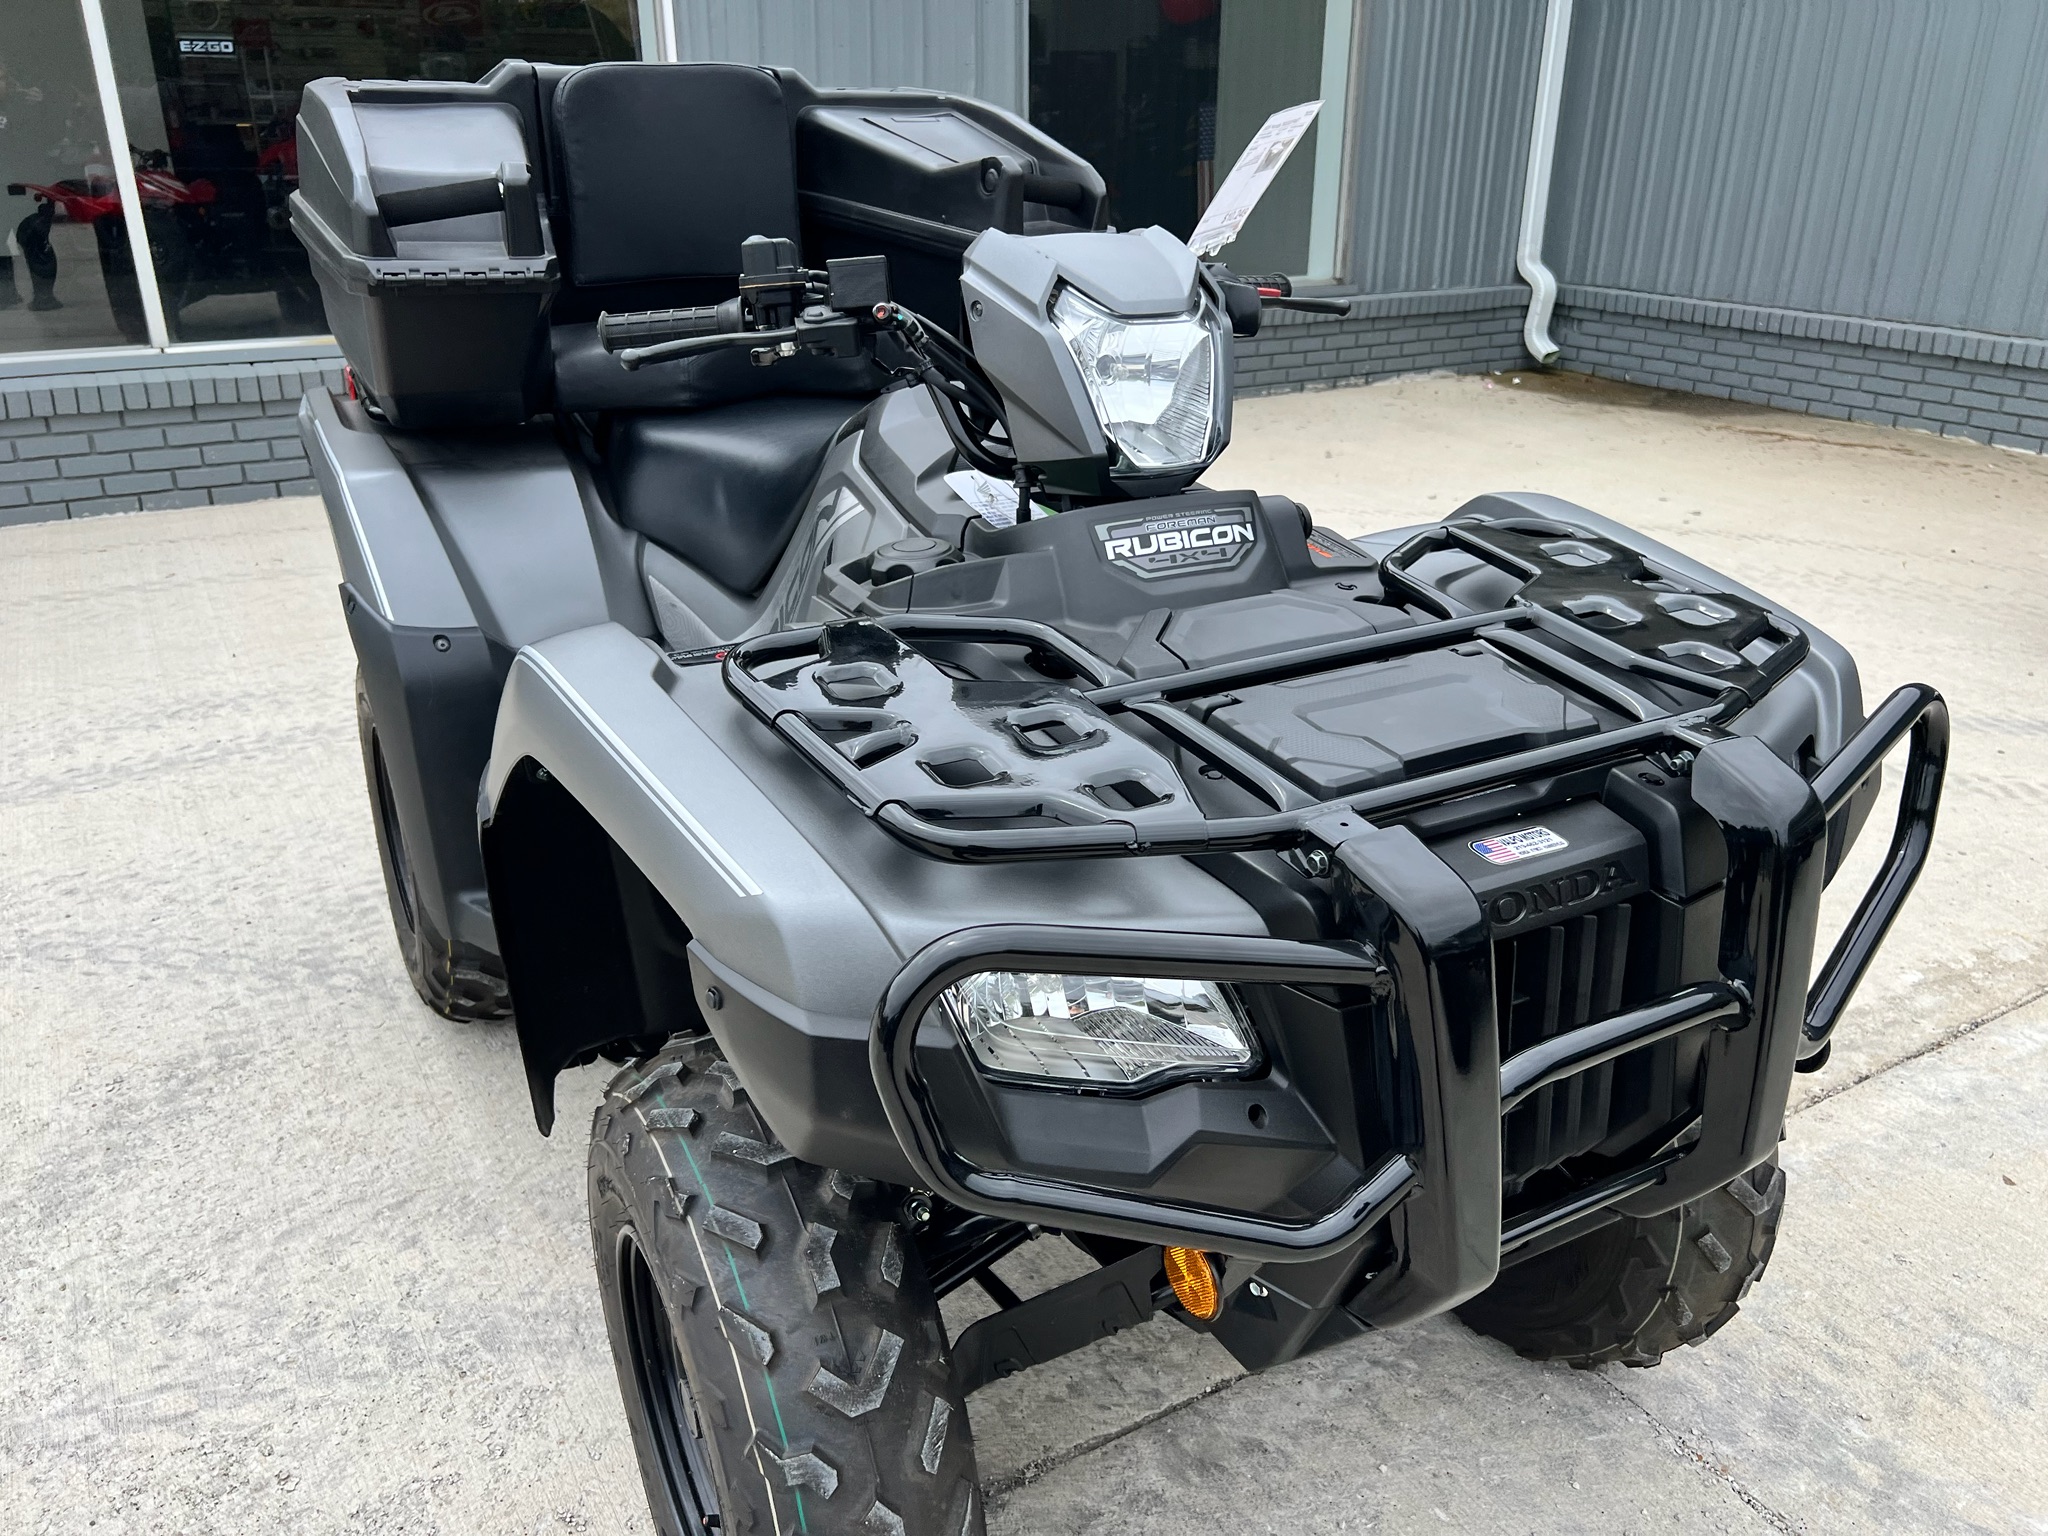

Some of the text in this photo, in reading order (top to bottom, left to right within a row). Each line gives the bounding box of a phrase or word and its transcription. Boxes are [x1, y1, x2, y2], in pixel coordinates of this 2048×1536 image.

[1145, 509, 1213, 521] POWER STEERING
[1145, 516, 1217, 532] FOREMAN
[1104, 523, 1255, 561] RUBICON
[1148, 547, 1228, 564] 4X4
[1484, 859, 1639, 927] ONDA
